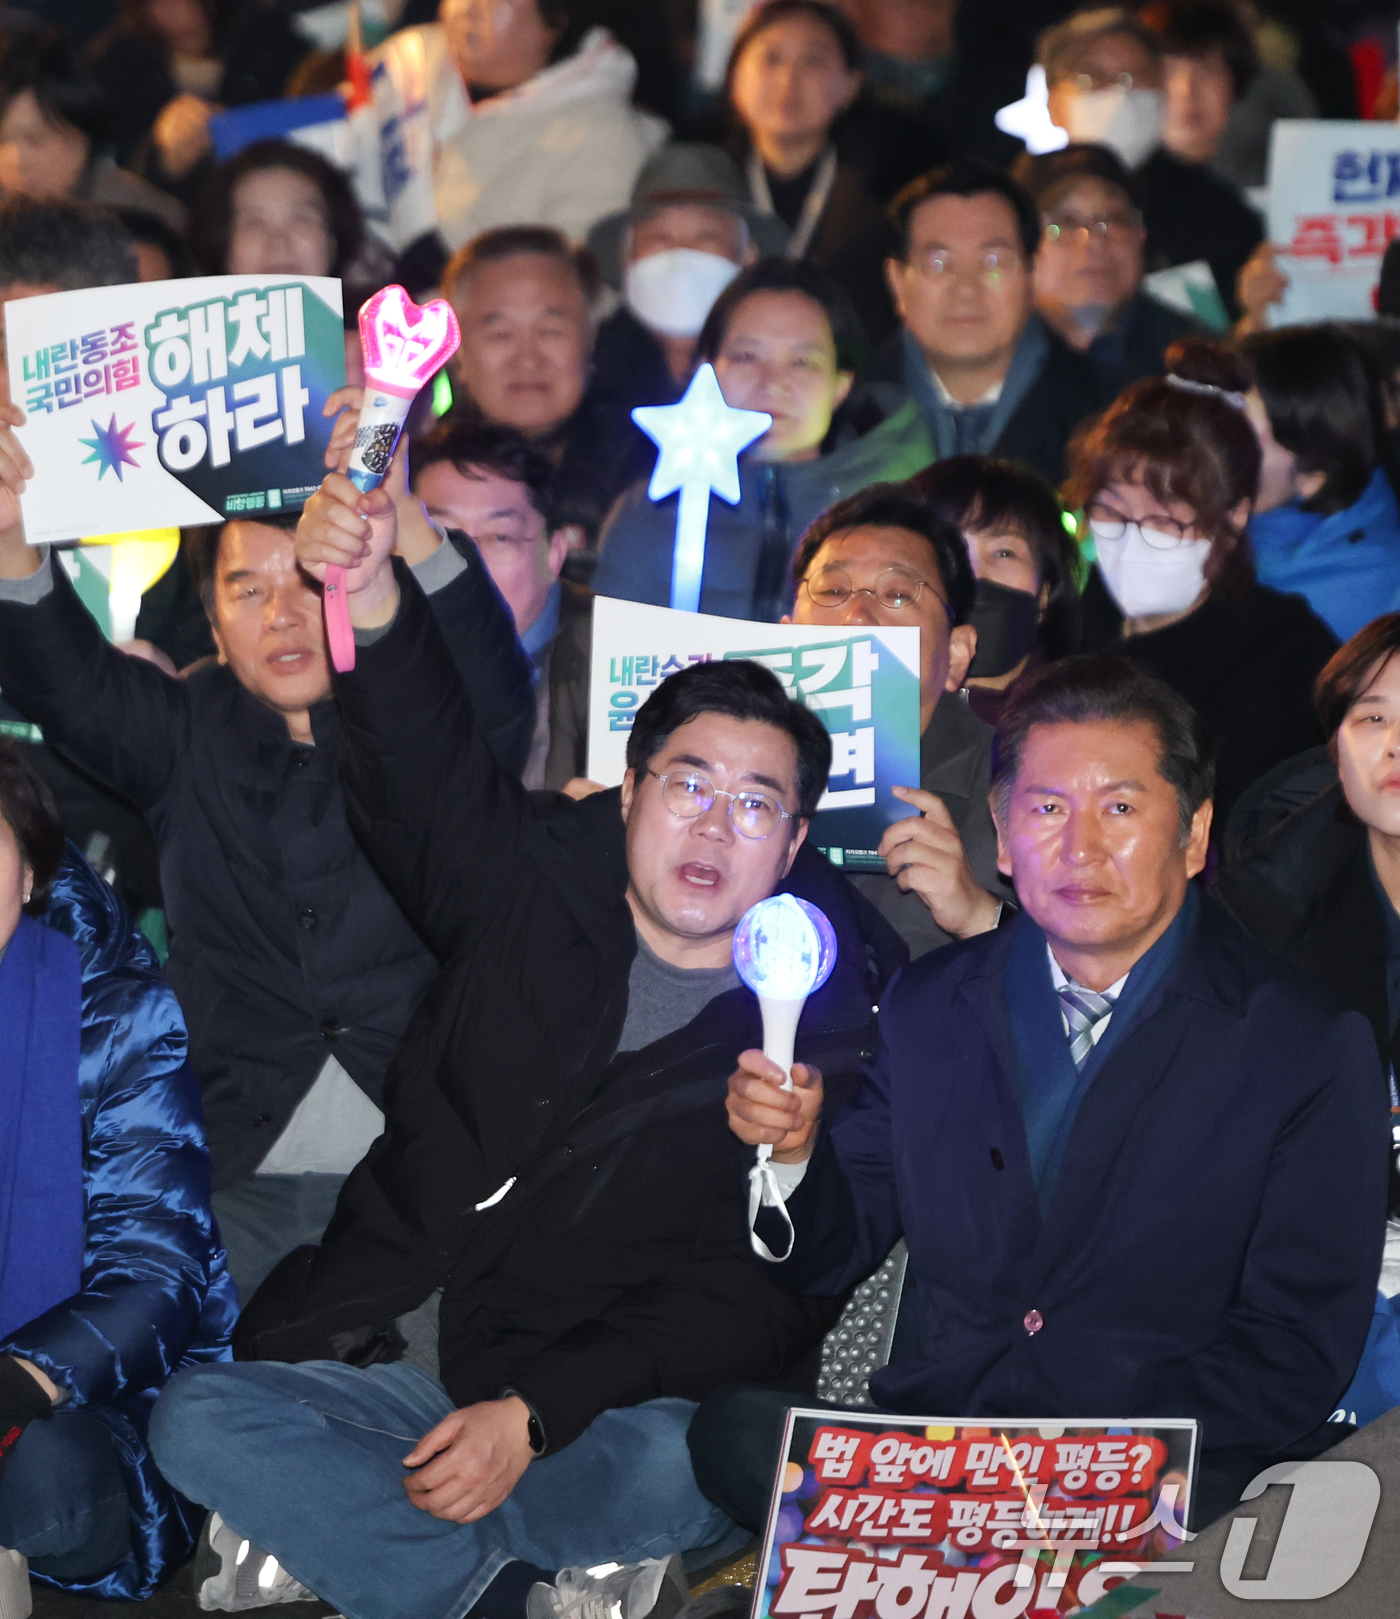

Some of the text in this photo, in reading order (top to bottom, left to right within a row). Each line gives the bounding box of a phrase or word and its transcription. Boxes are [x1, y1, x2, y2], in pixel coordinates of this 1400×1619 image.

[22, 321, 139, 381] 내란동조
[150, 287, 306, 386] 해체
[26, 355, 142, 414] 국민의힘
[157, 364, 310, 472] 하라
[609, 653, 713, 687] 내란수
[815, 727, 876, 812] 면
[814, 1433, 1153, 1490] 법 앞에 만인 평등?
[810, 1496, 1137, 1547] 시간도 평등하게!!
